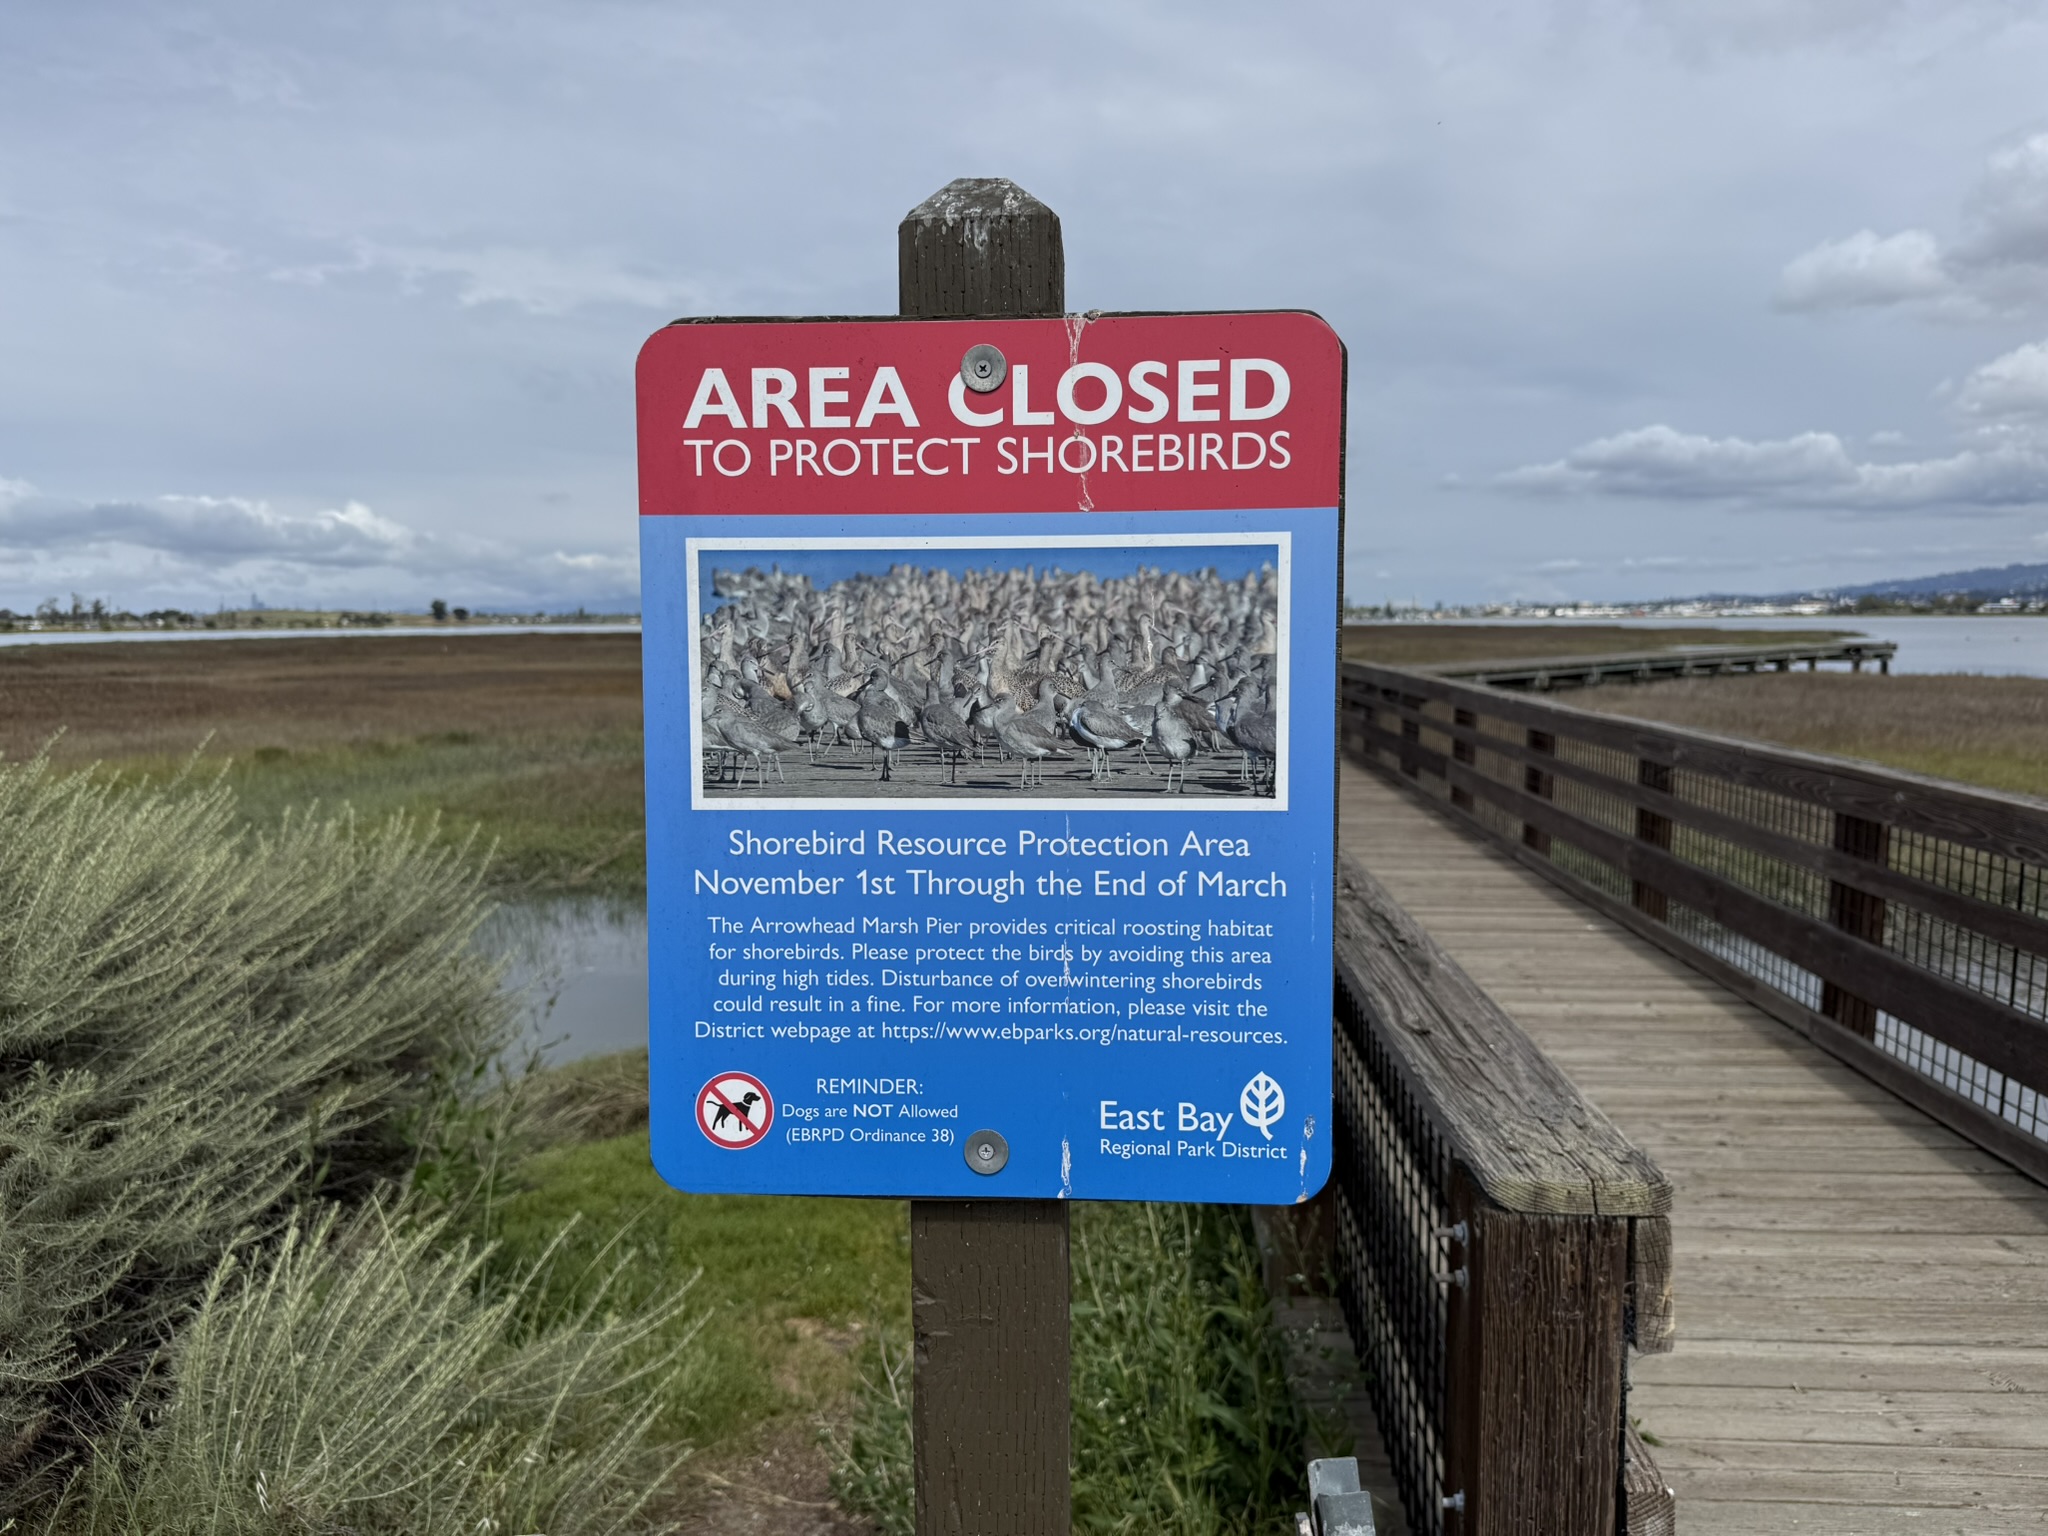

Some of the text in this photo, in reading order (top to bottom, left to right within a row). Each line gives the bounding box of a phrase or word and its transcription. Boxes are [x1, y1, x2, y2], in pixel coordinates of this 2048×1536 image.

[682, 358, 1291, 429] AREA CLOSED
[683, 431, 1291, 477] TO PROTECT SHOREBIRDS
[729, 829, 1251, 857] Shorebird Resource Protection Area
[694, 869, 1287, 904] November 1st Through the End of March
[707, 916, 1274, 942] The Arrowhead Marsh Pier provides critical roosting habitat
[708, 942, 1272, 968] for shorebirds. Please protect the birds by avoiding this area
[718, 968, 1263, 994] during high tides. Disturbance of overwintering shorebirds
[713, 995, 1268, 1020] could result in a fine. For more information, please visit the
[695, 1021, 1288, 1046] District webpage at https://www.ebparks.org/natural-resources.
[816, 1078, 923, 1095] REMINDER:
[782, 1103, 958, 1122] Dogs are NOT Allowed
[1100, 1100, 1234, 1142] East Bay
[786, 1127, 955, 1146] (EBRPD Ordinance 38)
[1100, 1138, 1288, 1160] Regional Park District
